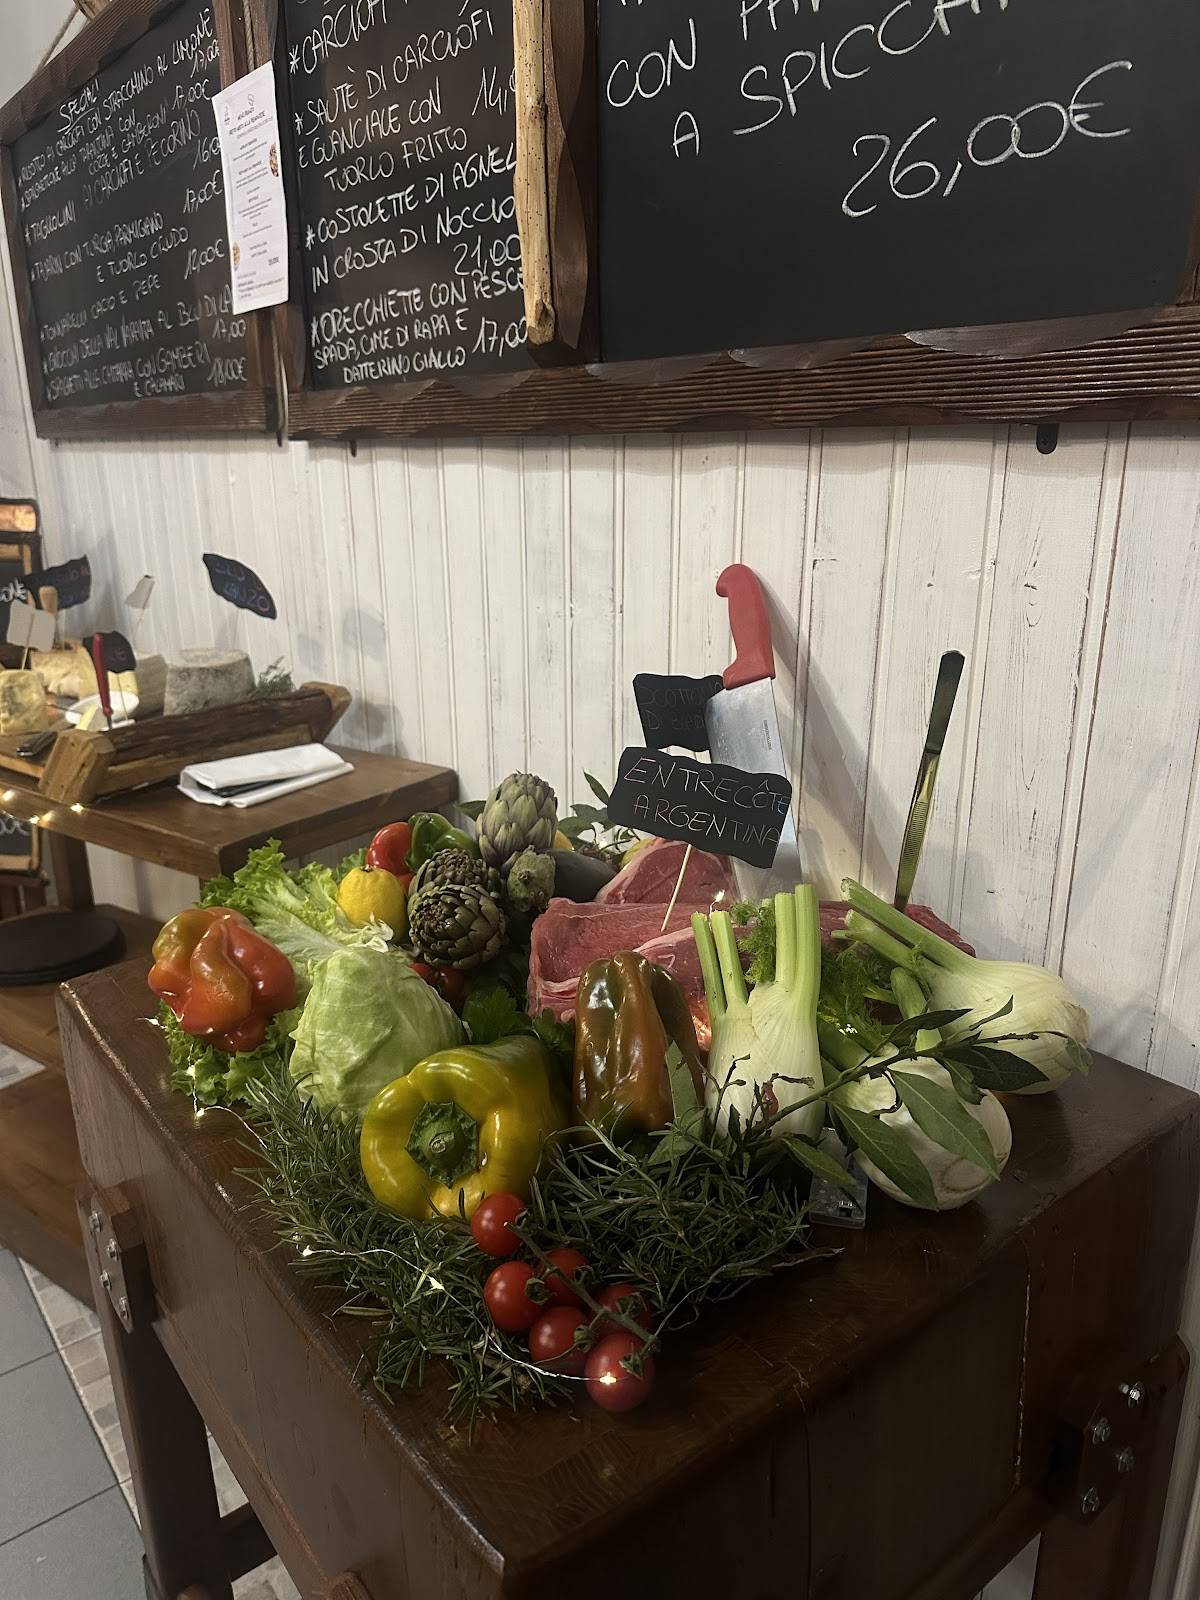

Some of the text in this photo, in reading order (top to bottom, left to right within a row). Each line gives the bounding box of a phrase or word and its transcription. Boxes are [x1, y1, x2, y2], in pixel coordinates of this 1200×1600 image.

[365, 65, 387, 100] DI
[393, 8, 493, 84] CARCIOFI
[606, 18, 697, 107] CON
[672, 110, 700, 157] A
[732, 0, 1006, 135] SPICC
[87, 107, 101, 134] CON
[118, 109, 136, 133] CON
[298, 144, 309, 169] E
[311, 104, 401, 166] GUANCIALE
[409, 75, 442, 125] CON
[841, 60, 1132, 218] 26,00€
[324, 127, 467, 193] TUORLO FRITTO
[317, 184, 419, 243] COSTOLETTE
[425, 172, 444, 204] DI
[311, 255, 329, 293] IN
[333, 238, 397, 279] CROSTA
[400, 225, 427, 254] DI
[118, 290, 128, 305] E
[320, 287, 424, 343] ORECCHIETTE
[429, 278, 467, 309] CON
[396, 324, 410, 347] DI
[414, 313, 451, 340] RAPA
[455, 307, 470, 331] E
[412, 345, 466, 373] GIALLO
[623, 757, 790, 816] ENTRECÔTE
[633, 794, 781, 847] ARGENTINA
